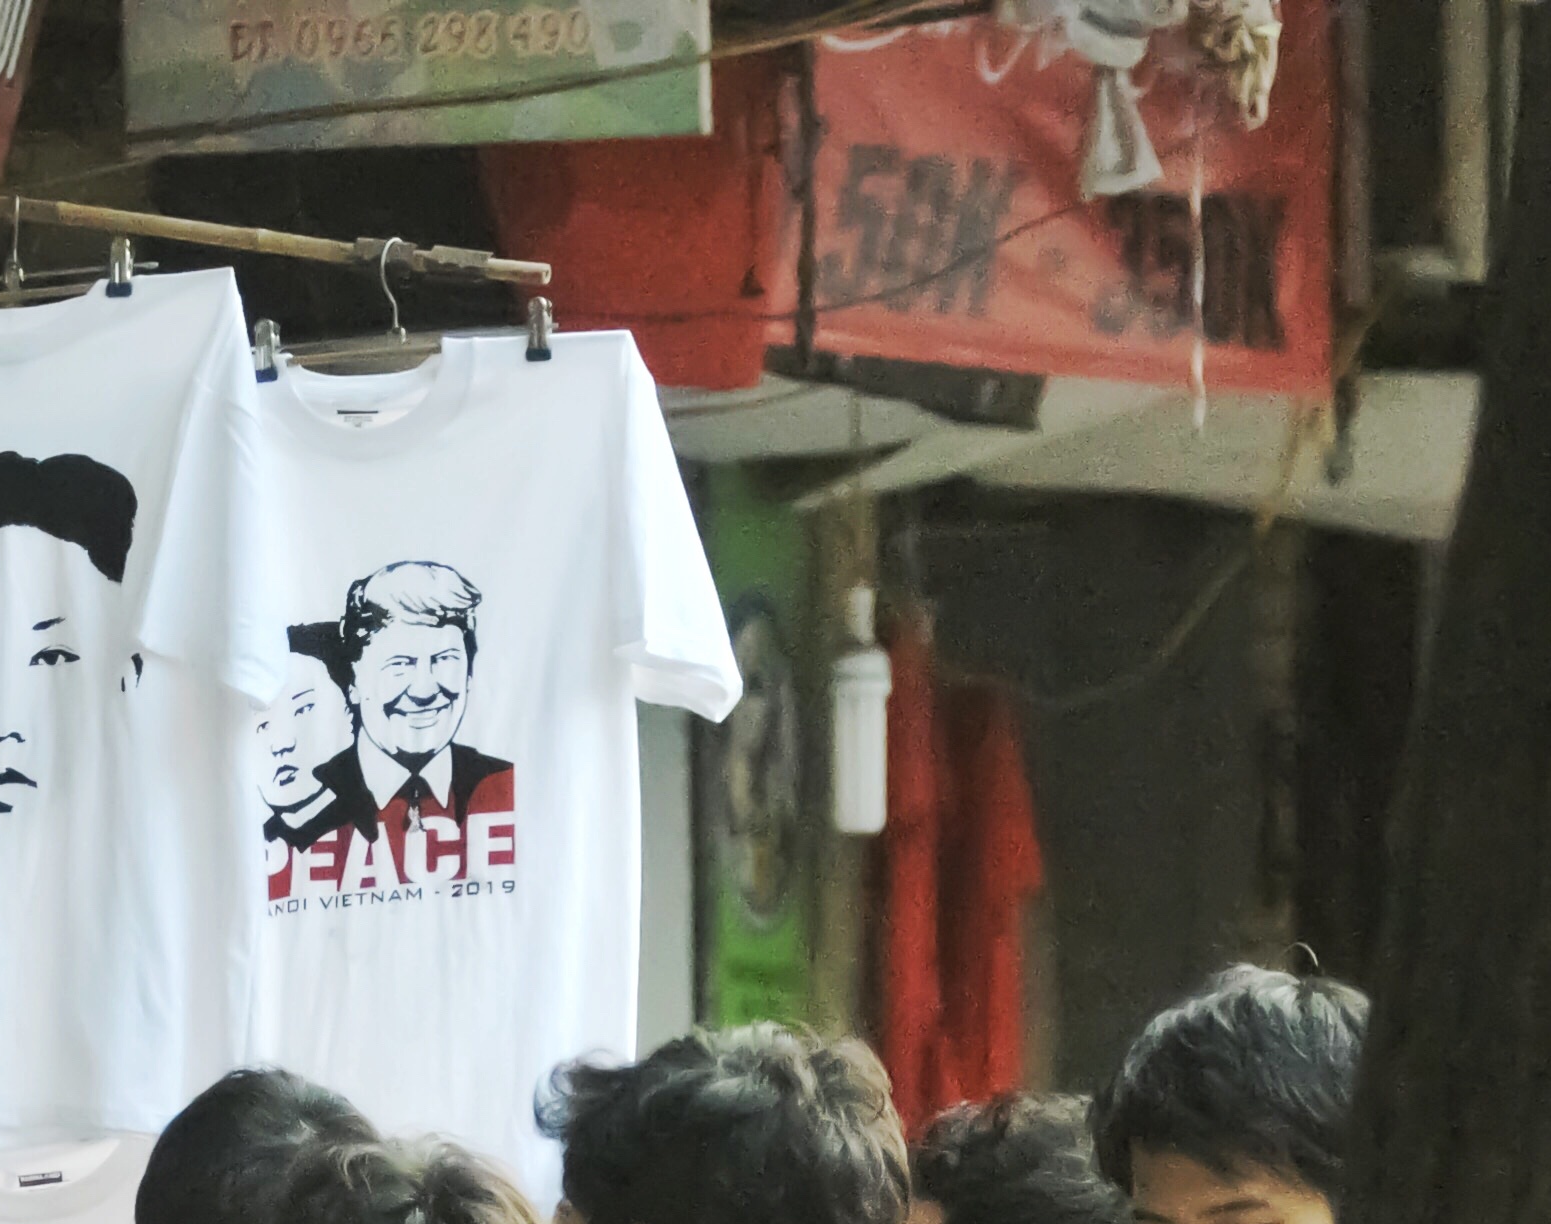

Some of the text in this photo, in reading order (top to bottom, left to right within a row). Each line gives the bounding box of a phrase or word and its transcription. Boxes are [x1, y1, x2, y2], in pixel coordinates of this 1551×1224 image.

[266, 813, 515, 902] PEACE
[319, 886, 423, 908] VIETNAM
[451, 879, 517, 898] 2019
